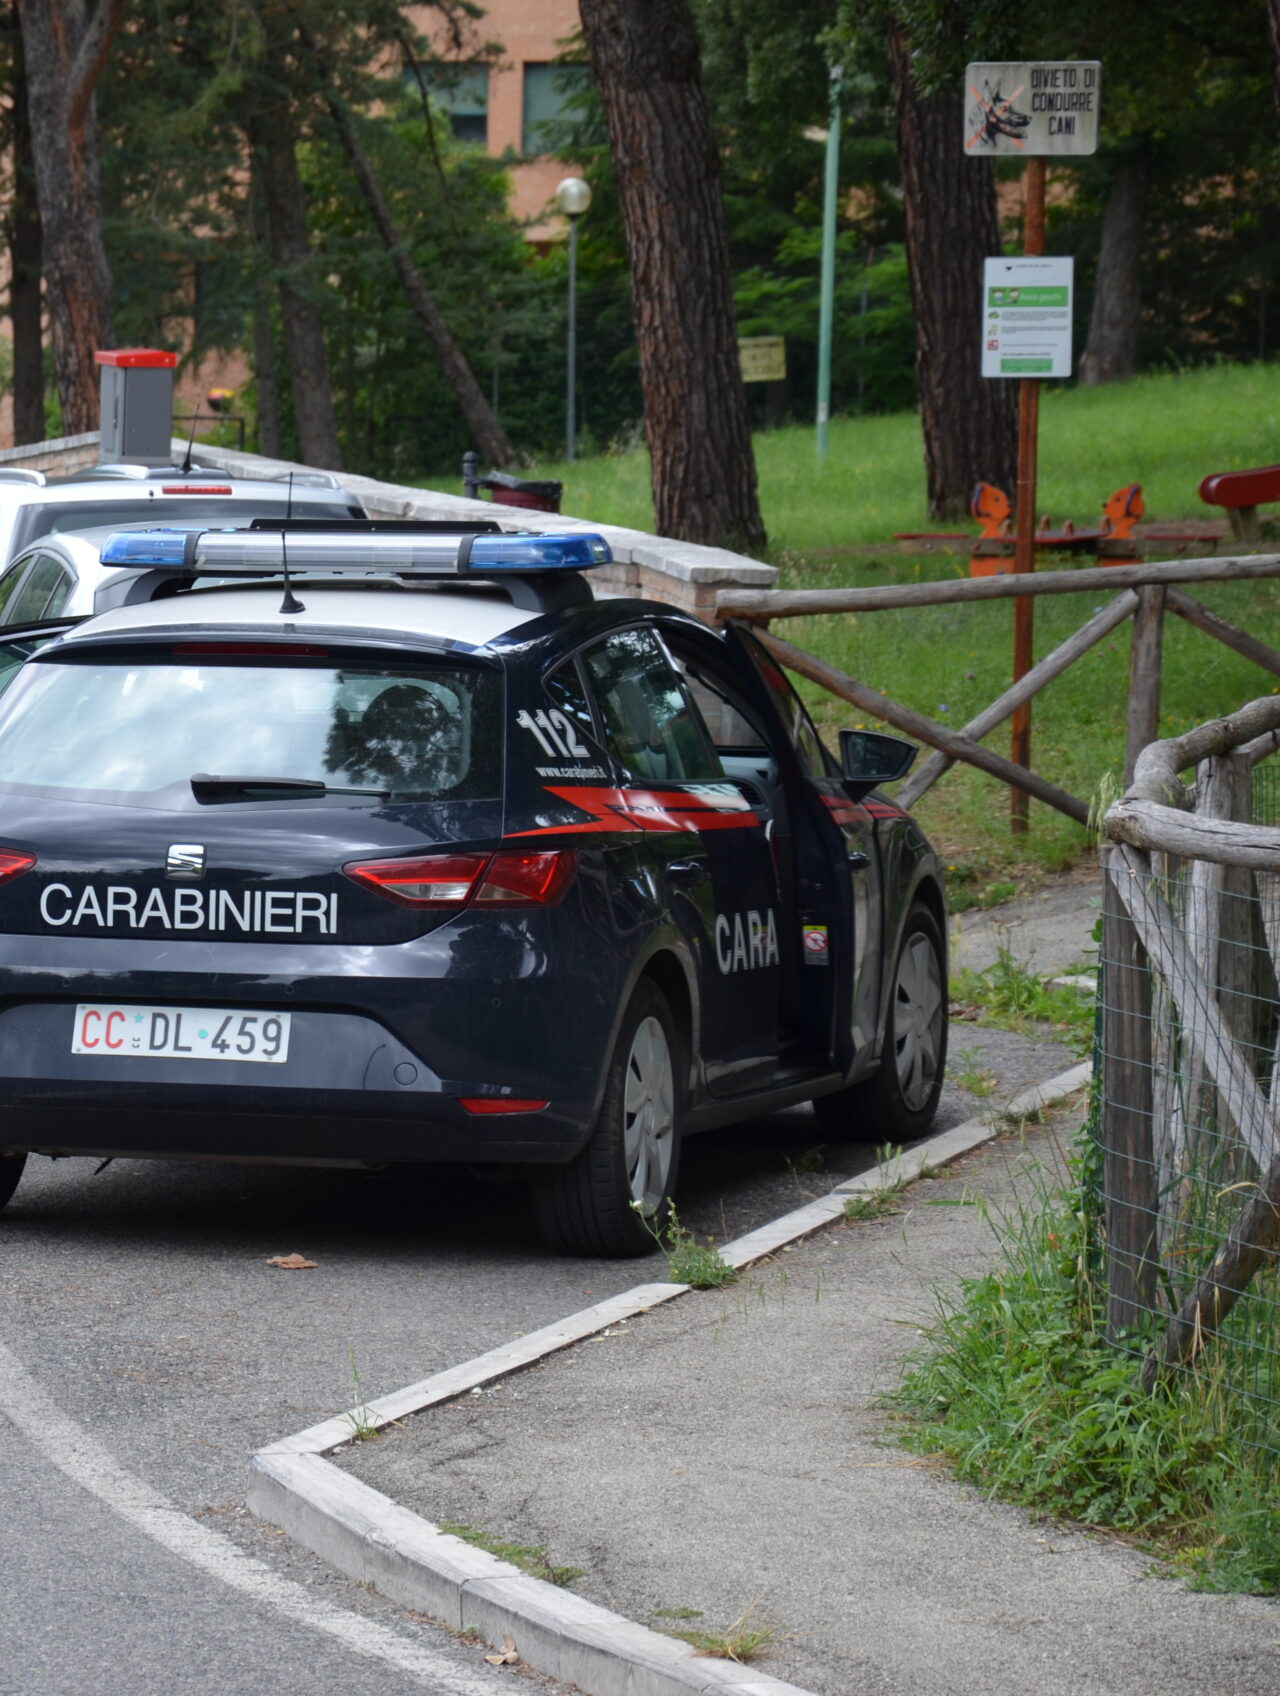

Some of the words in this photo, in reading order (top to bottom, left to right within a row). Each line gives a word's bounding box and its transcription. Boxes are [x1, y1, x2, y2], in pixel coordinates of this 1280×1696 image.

[1031, 69, 1077, 88] DIVIETO
[1084, 68, 1096, 88] DI
[1032, 92, 1094, 112] CONDURRE
[1049, 116, 1076, 136] CANI
[516, 708, 590, 758] 112
[39, 883, 338, 934] CARABINIERI
[715, 908, 780, 975] CARA
[81, 1010, 126, 1049] CC
[149, 1012, 193, 1052] DL
[211, 1015, 282, 1056] 459
